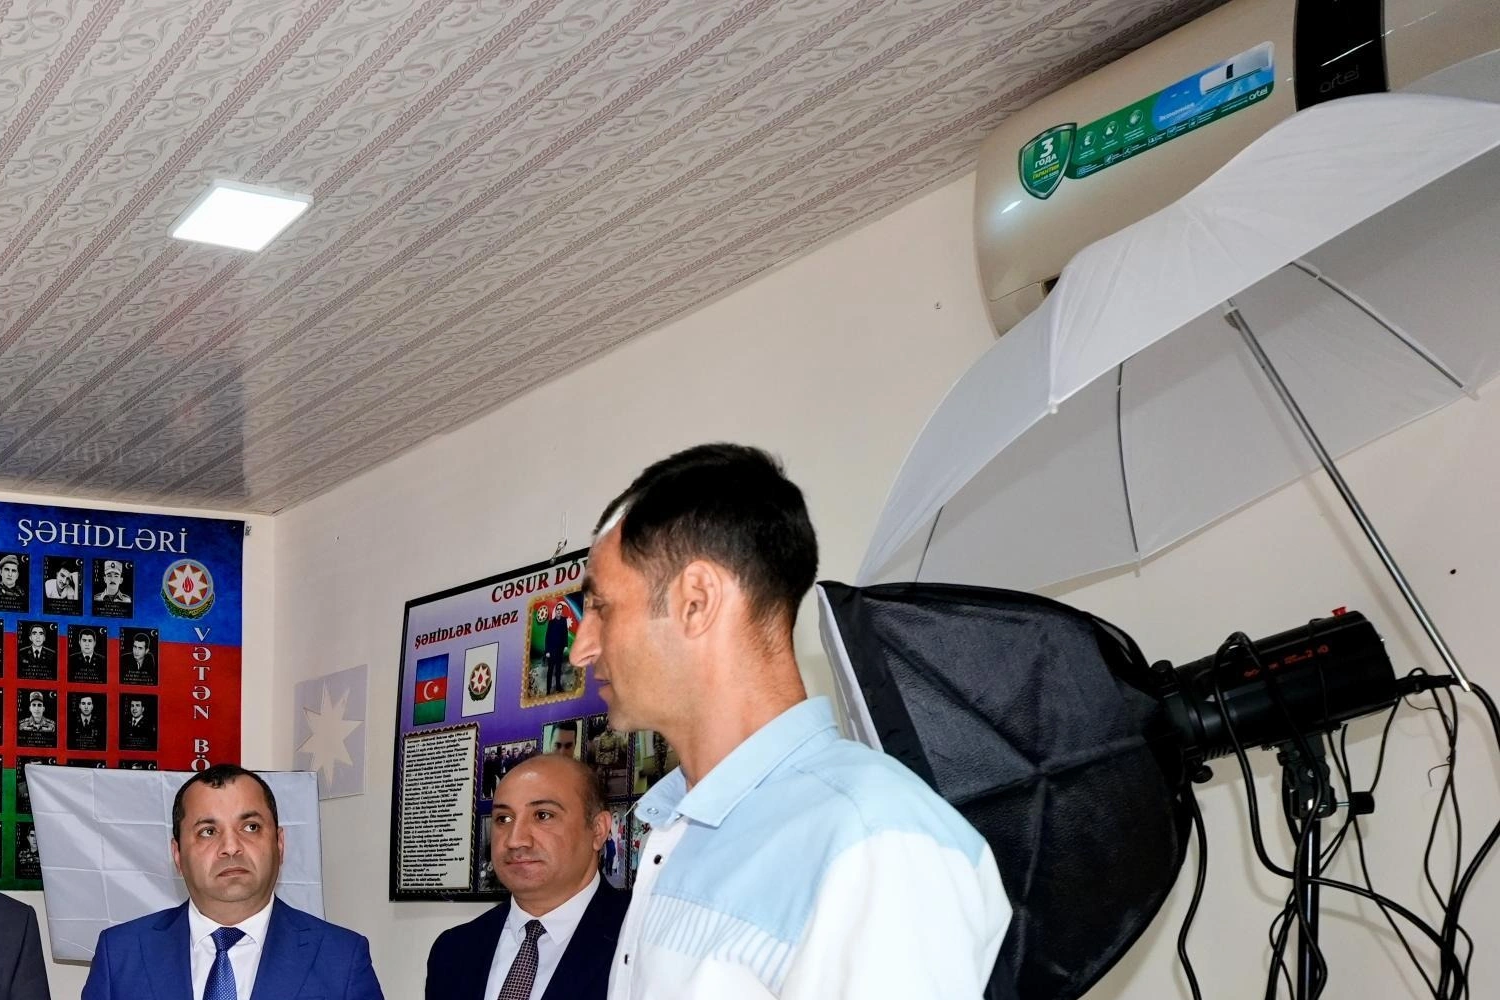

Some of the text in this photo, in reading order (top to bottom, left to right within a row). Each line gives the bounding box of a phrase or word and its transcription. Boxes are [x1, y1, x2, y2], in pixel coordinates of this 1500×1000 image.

[1034, 153, 1058, 169] ГОДА
[1039, 137, 1054, 159] 3
[17, 518, 188, 554] ŞƏHİDLƏRİ
[491, 571, 550, 603] CƏSUR
[414, 609, 519, 650] ŞƏHİDLƏR ÖLMƏZ
[191, 627, 212, 720] VƏTƏN
